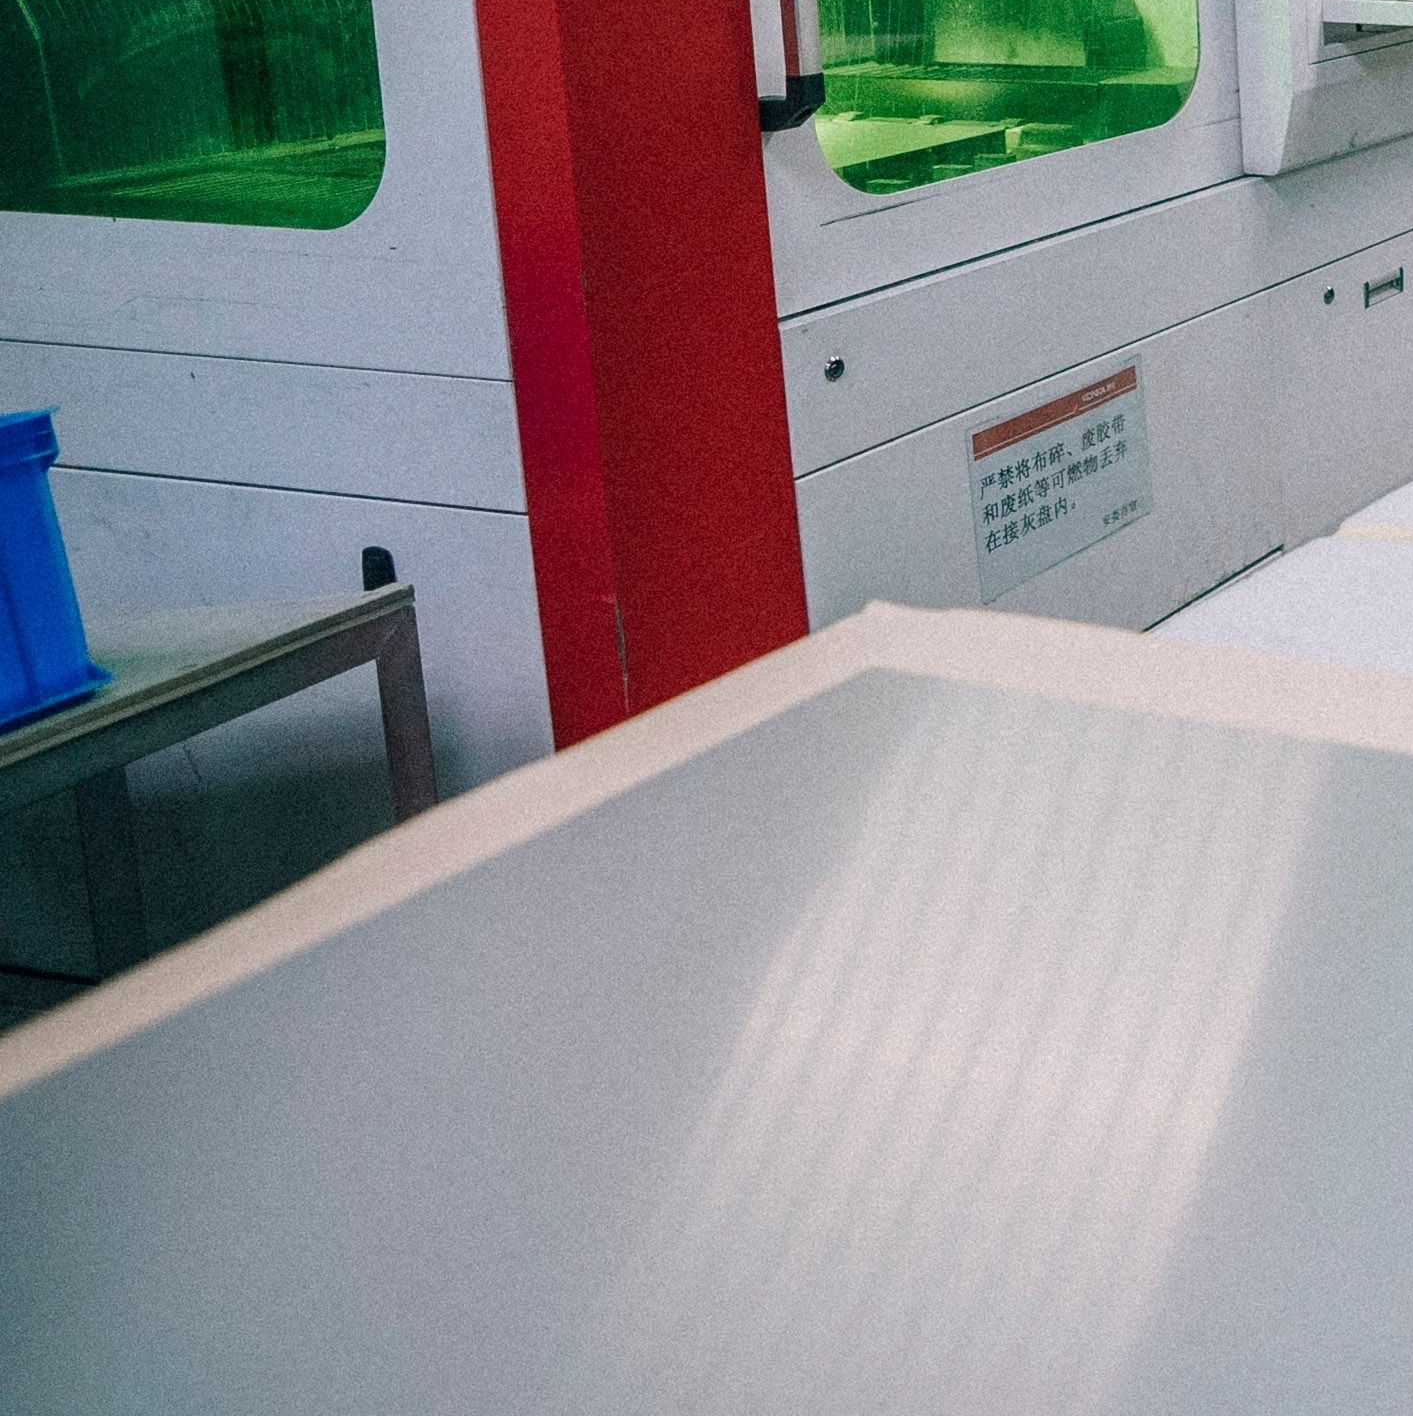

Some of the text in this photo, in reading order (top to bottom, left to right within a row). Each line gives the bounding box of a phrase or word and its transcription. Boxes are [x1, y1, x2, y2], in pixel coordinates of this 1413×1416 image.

[979, 413, 1126, 501] 严禁将布碎、废胶带
[982, 439, 1129, 525] 和废纸等可燃物丢弃
[984, 496, 1077, 554] 在接灰盘内。
